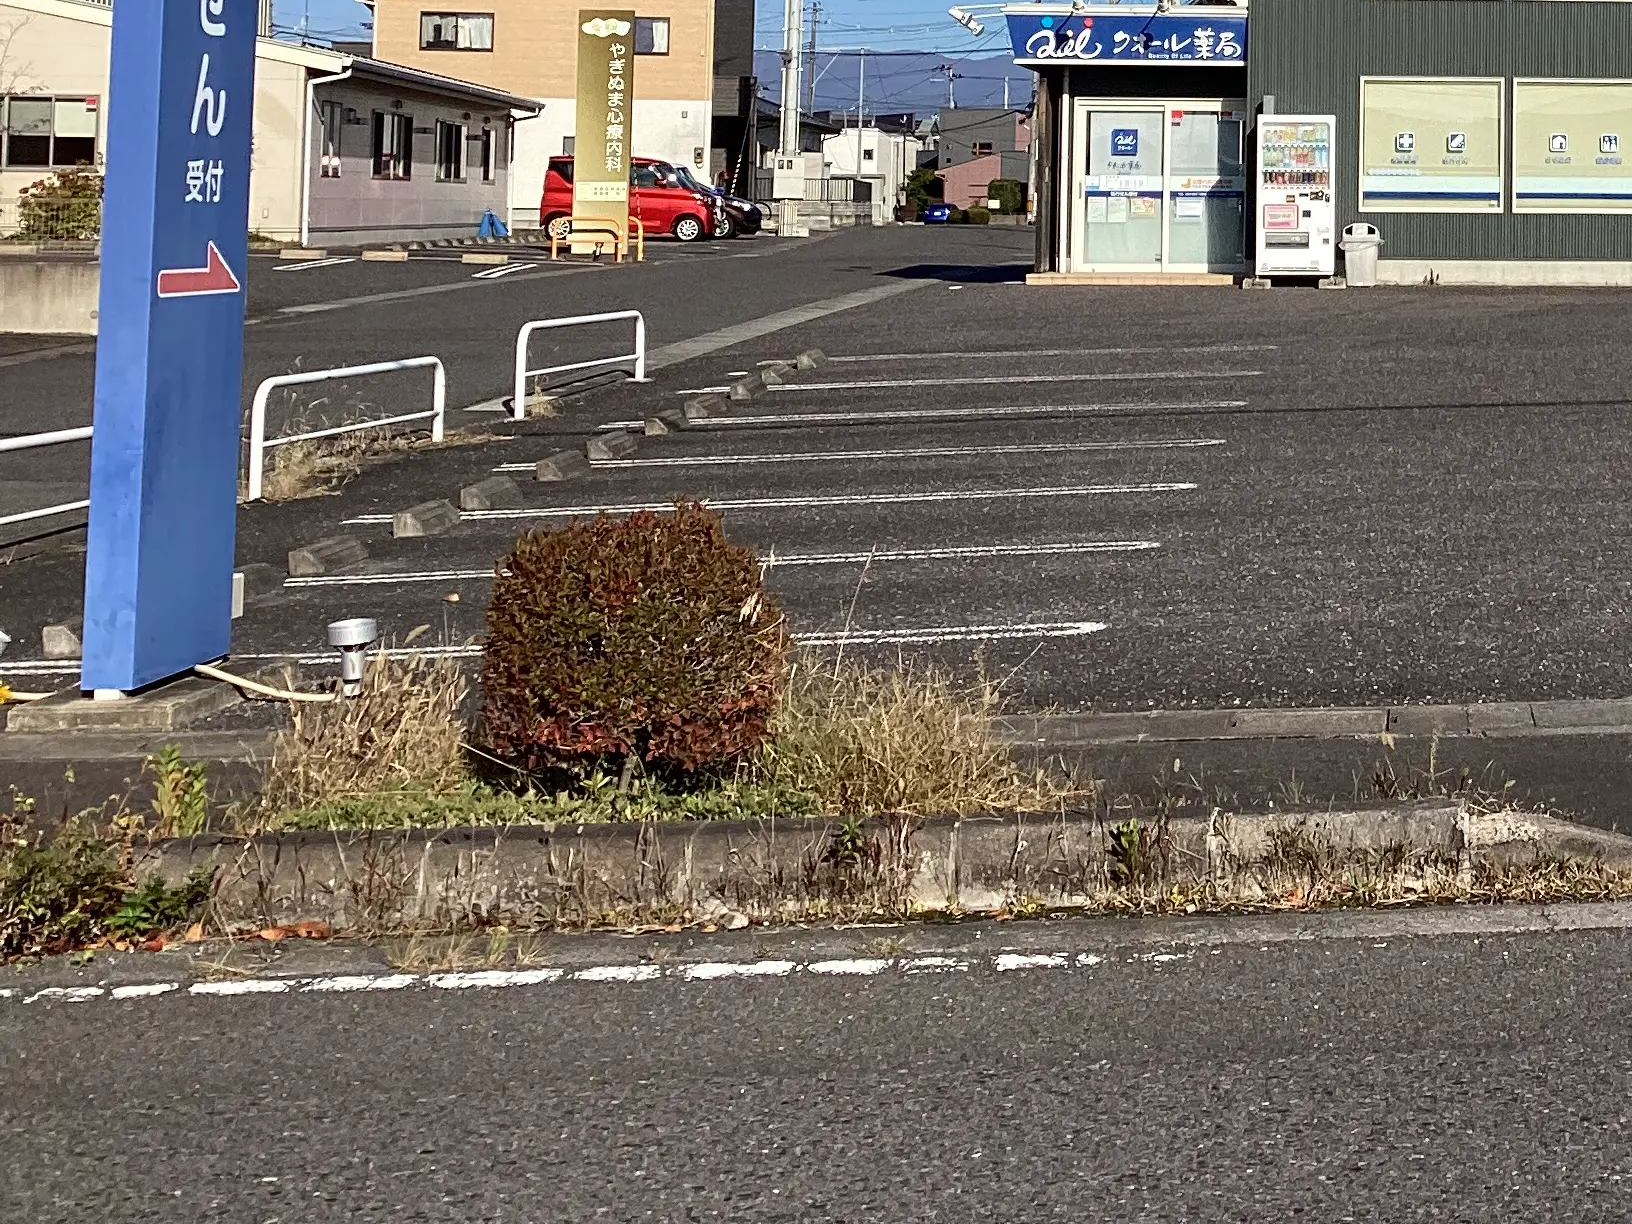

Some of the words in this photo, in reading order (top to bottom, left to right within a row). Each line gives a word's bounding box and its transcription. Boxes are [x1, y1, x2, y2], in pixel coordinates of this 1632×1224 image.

[605, 42, 627, 173] やぎぬま心療内科
[184, 159, 225, 204] 受付
